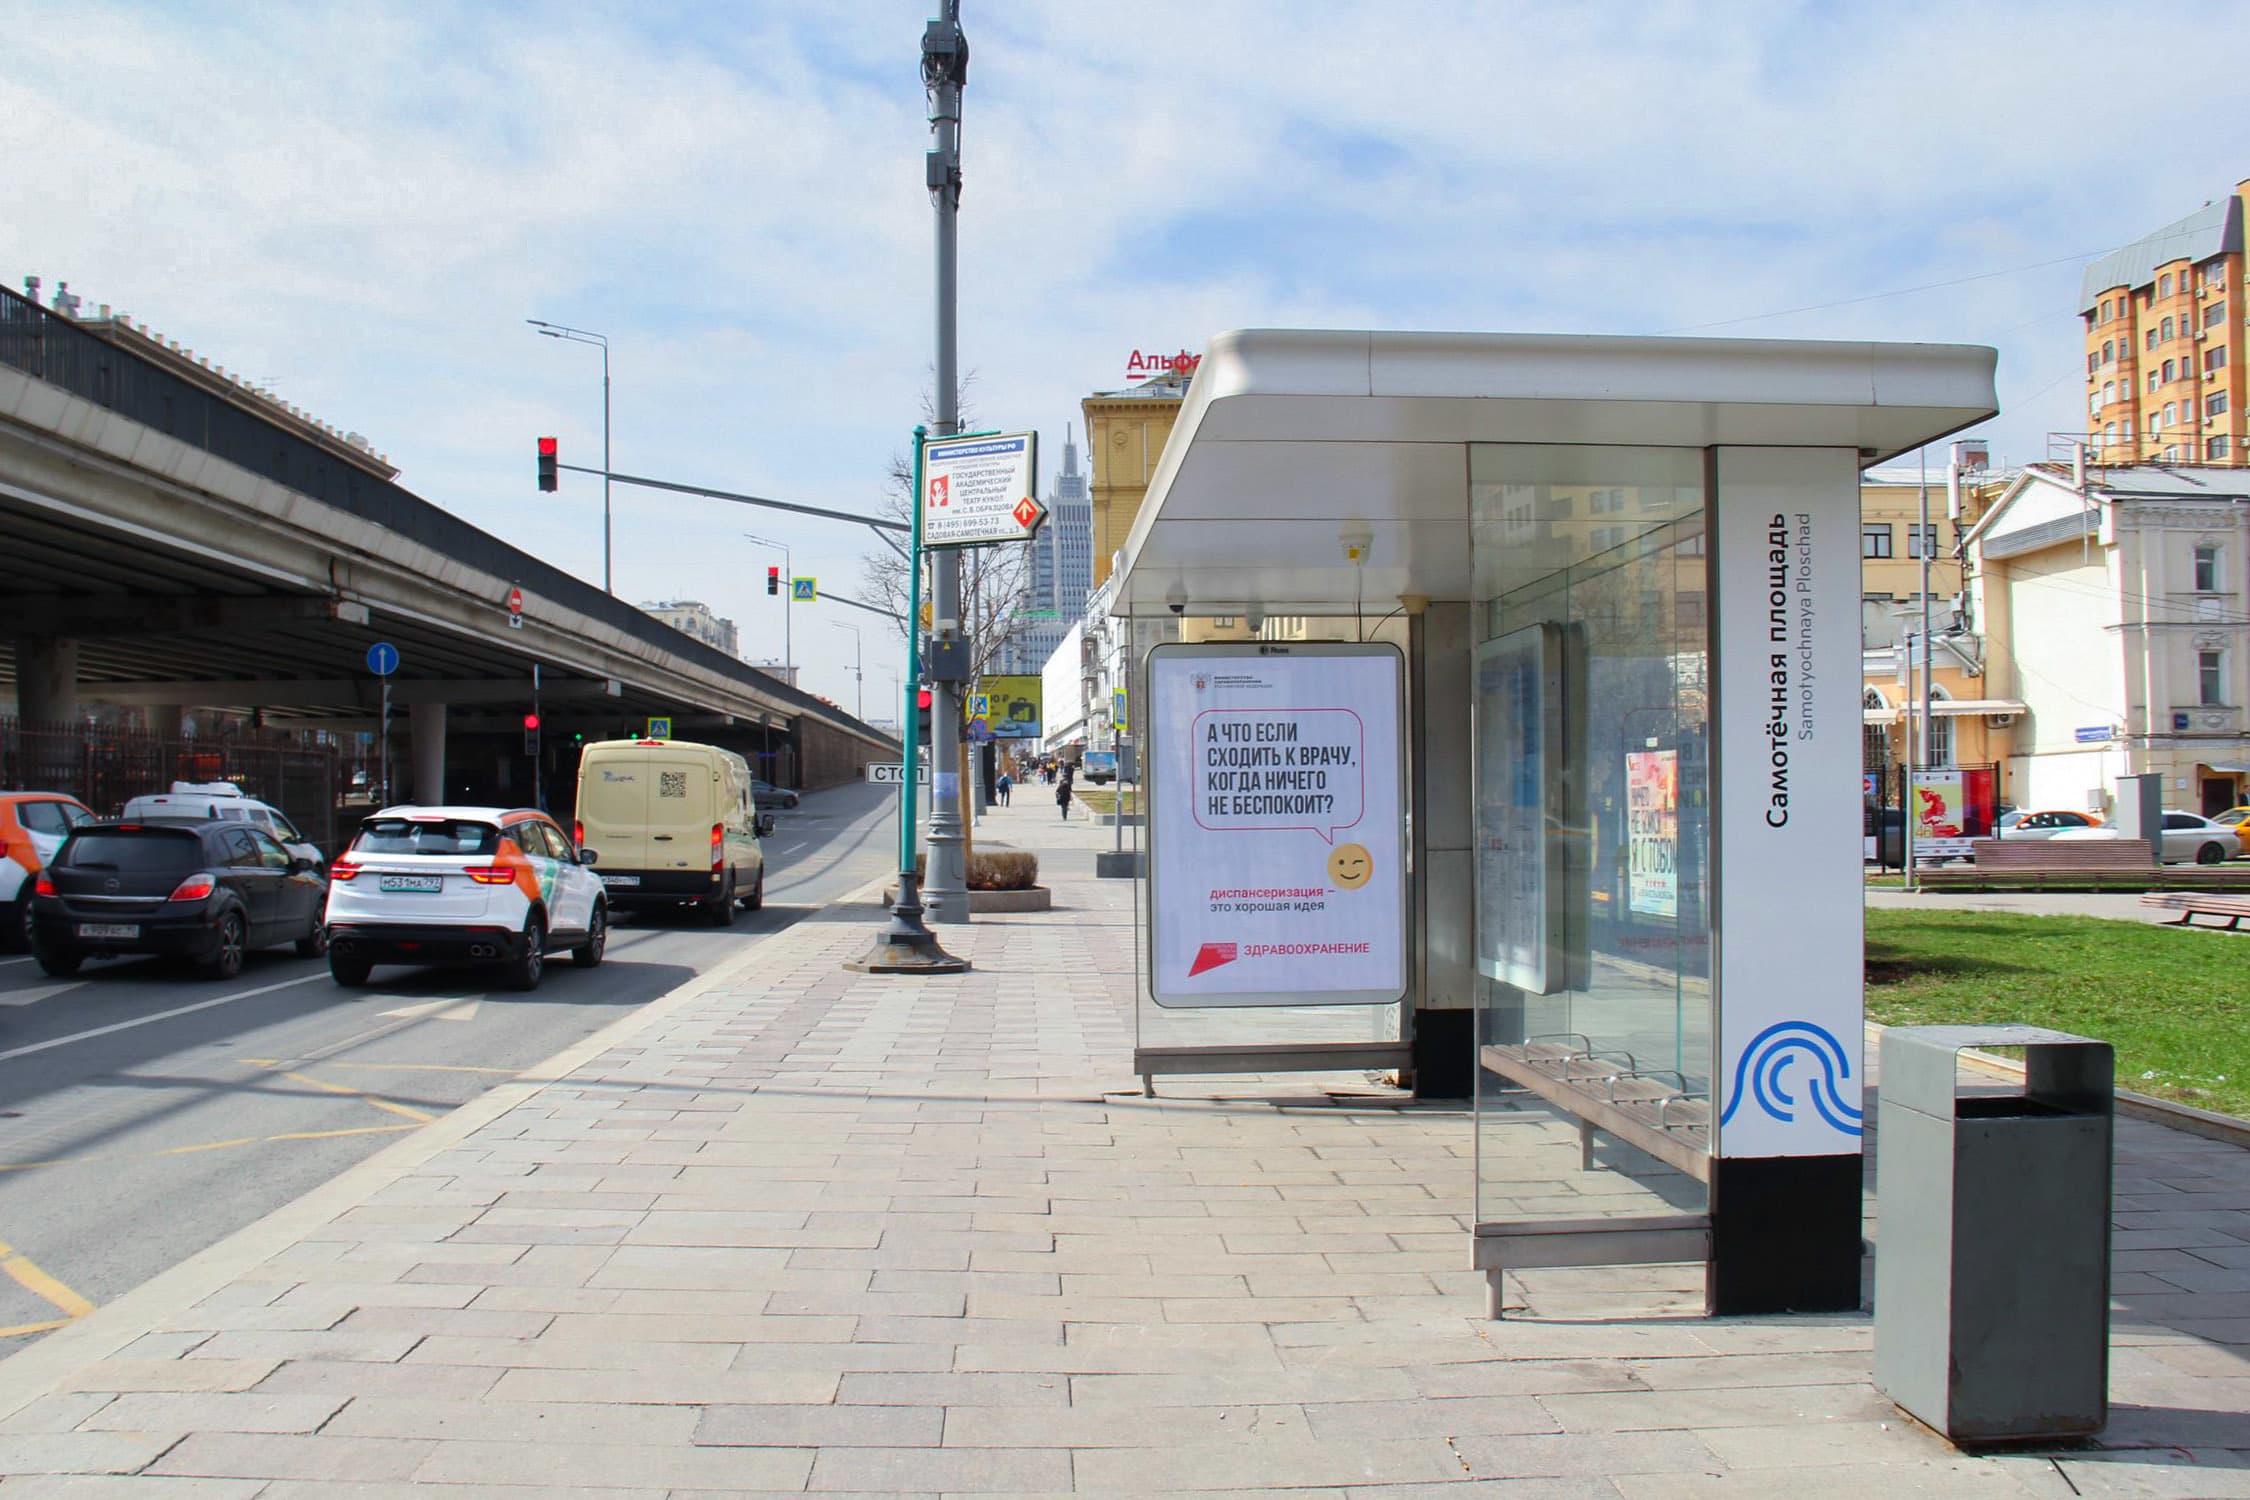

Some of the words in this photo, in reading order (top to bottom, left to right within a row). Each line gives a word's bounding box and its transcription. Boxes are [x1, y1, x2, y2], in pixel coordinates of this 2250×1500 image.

[952, 466, 1015, 478] ГОСУДАРСТВЕННЫЙ
[956, 477, 1011, 487] АКАДЕМИЧЕСКИЙ
[960, 486, 1007, 497] ЦЕНТРАЛЬНЫЙ
[963, 497, 982, 505] ТЕАТР
[976, 503, 1013, 512] ОБРАЗЦОВА
[963, 517, 999, 527] 699-53-73
[927, 528, 997, 540] САДОВАЯ-САМОТЕЧНАЯ
[1795, 513, 1812, 594] Ploschad
[1769, 513, 1789, 642] площадь
[1797, 598, 1815, 741] Samotyochnaya
[1207, 723, 1218, 743] А
[1222, 723, 1251, 743] ЧТО
[1256, 723, 1298, 742] ЕСЛИ
[1766, 653, 1789, 828] Самотёчная
[1208, 747, 1281, 769] СХОДИТЬ
[1286, 746, 1296, 766] К
[1300, 746, 1356, 768] ВРАЧУ,
[1208, 771, 1261, 793] КОГДА
[1265, 770, 1326, 790] НИЧЕГО
[1209, 796, 1228, 815] НЕ
[1233, 794, 1334, 815] БЕСПОКОИТ?
[1210, 887, 1324, 900] диспансеризация
[1210, 902, 1231, 913] это
[1234, 901, 1290, 914] хорошая
[1294, 901, 1325, 913] идея
[1244, 943, 1370, 957] ЗДРАВООХРАНЕНИЕ
